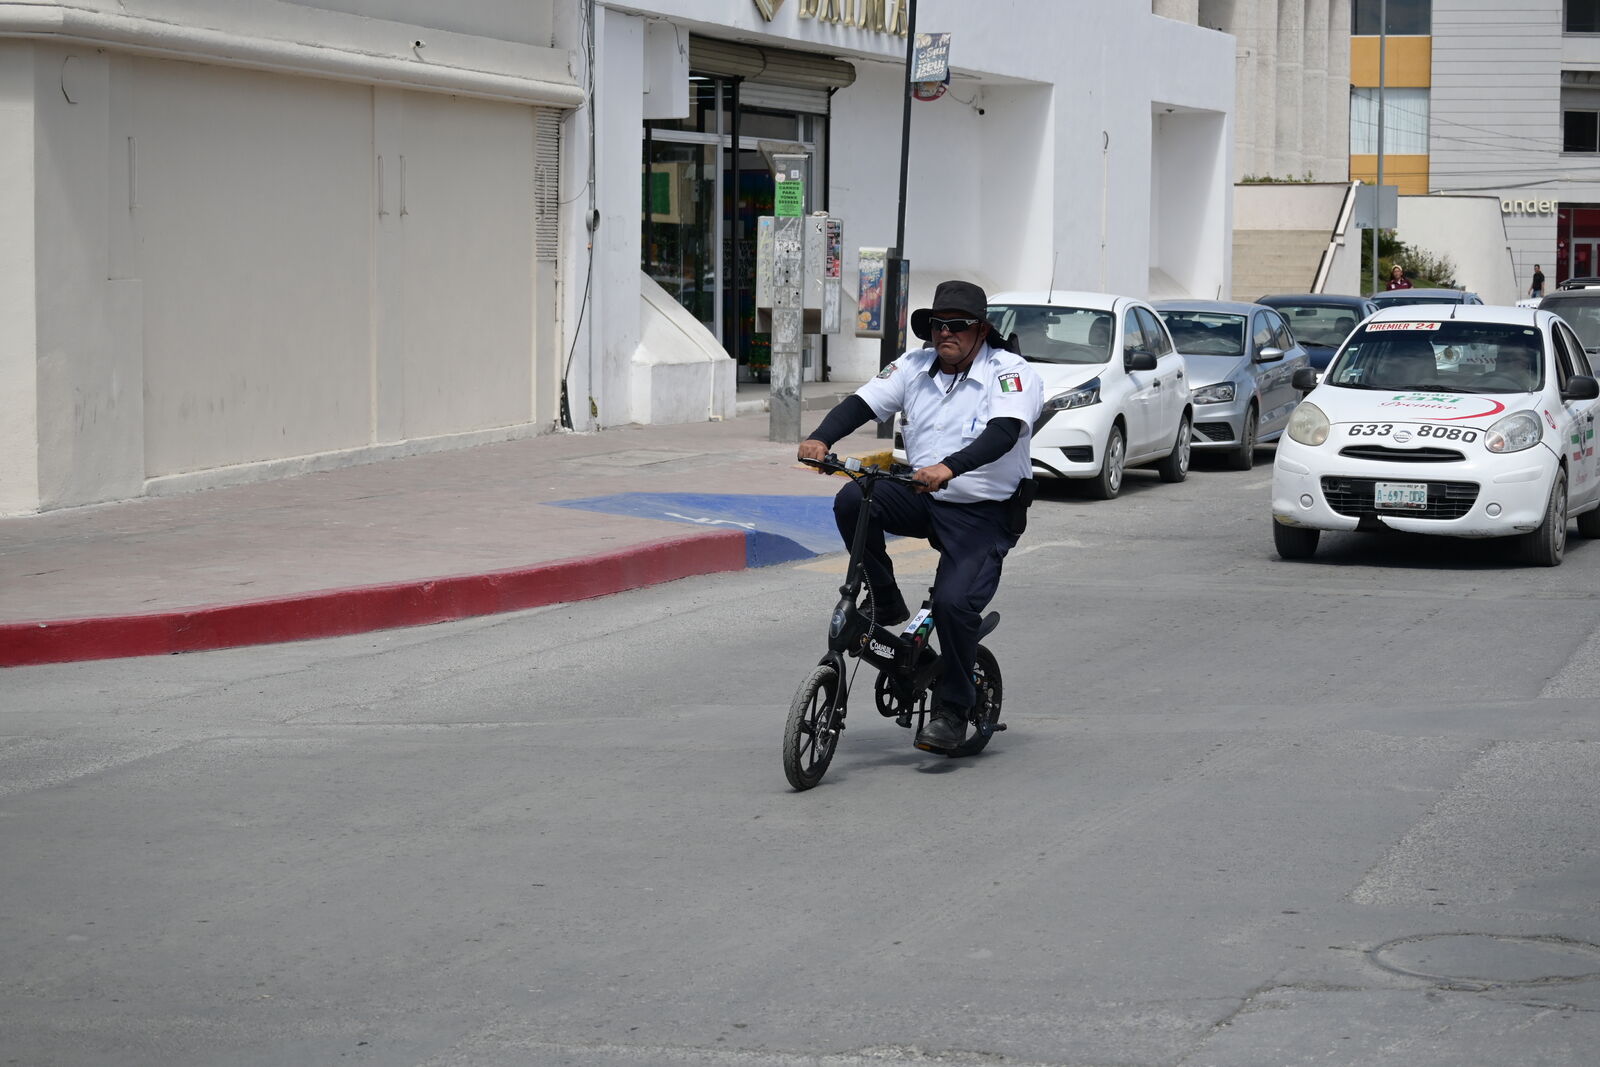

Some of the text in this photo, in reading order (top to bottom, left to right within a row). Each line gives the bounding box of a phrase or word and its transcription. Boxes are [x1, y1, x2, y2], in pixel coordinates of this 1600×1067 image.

[1369, 323, 1410, 331] PREMIER
[1348, 424, 1478, 443] 633 8080
